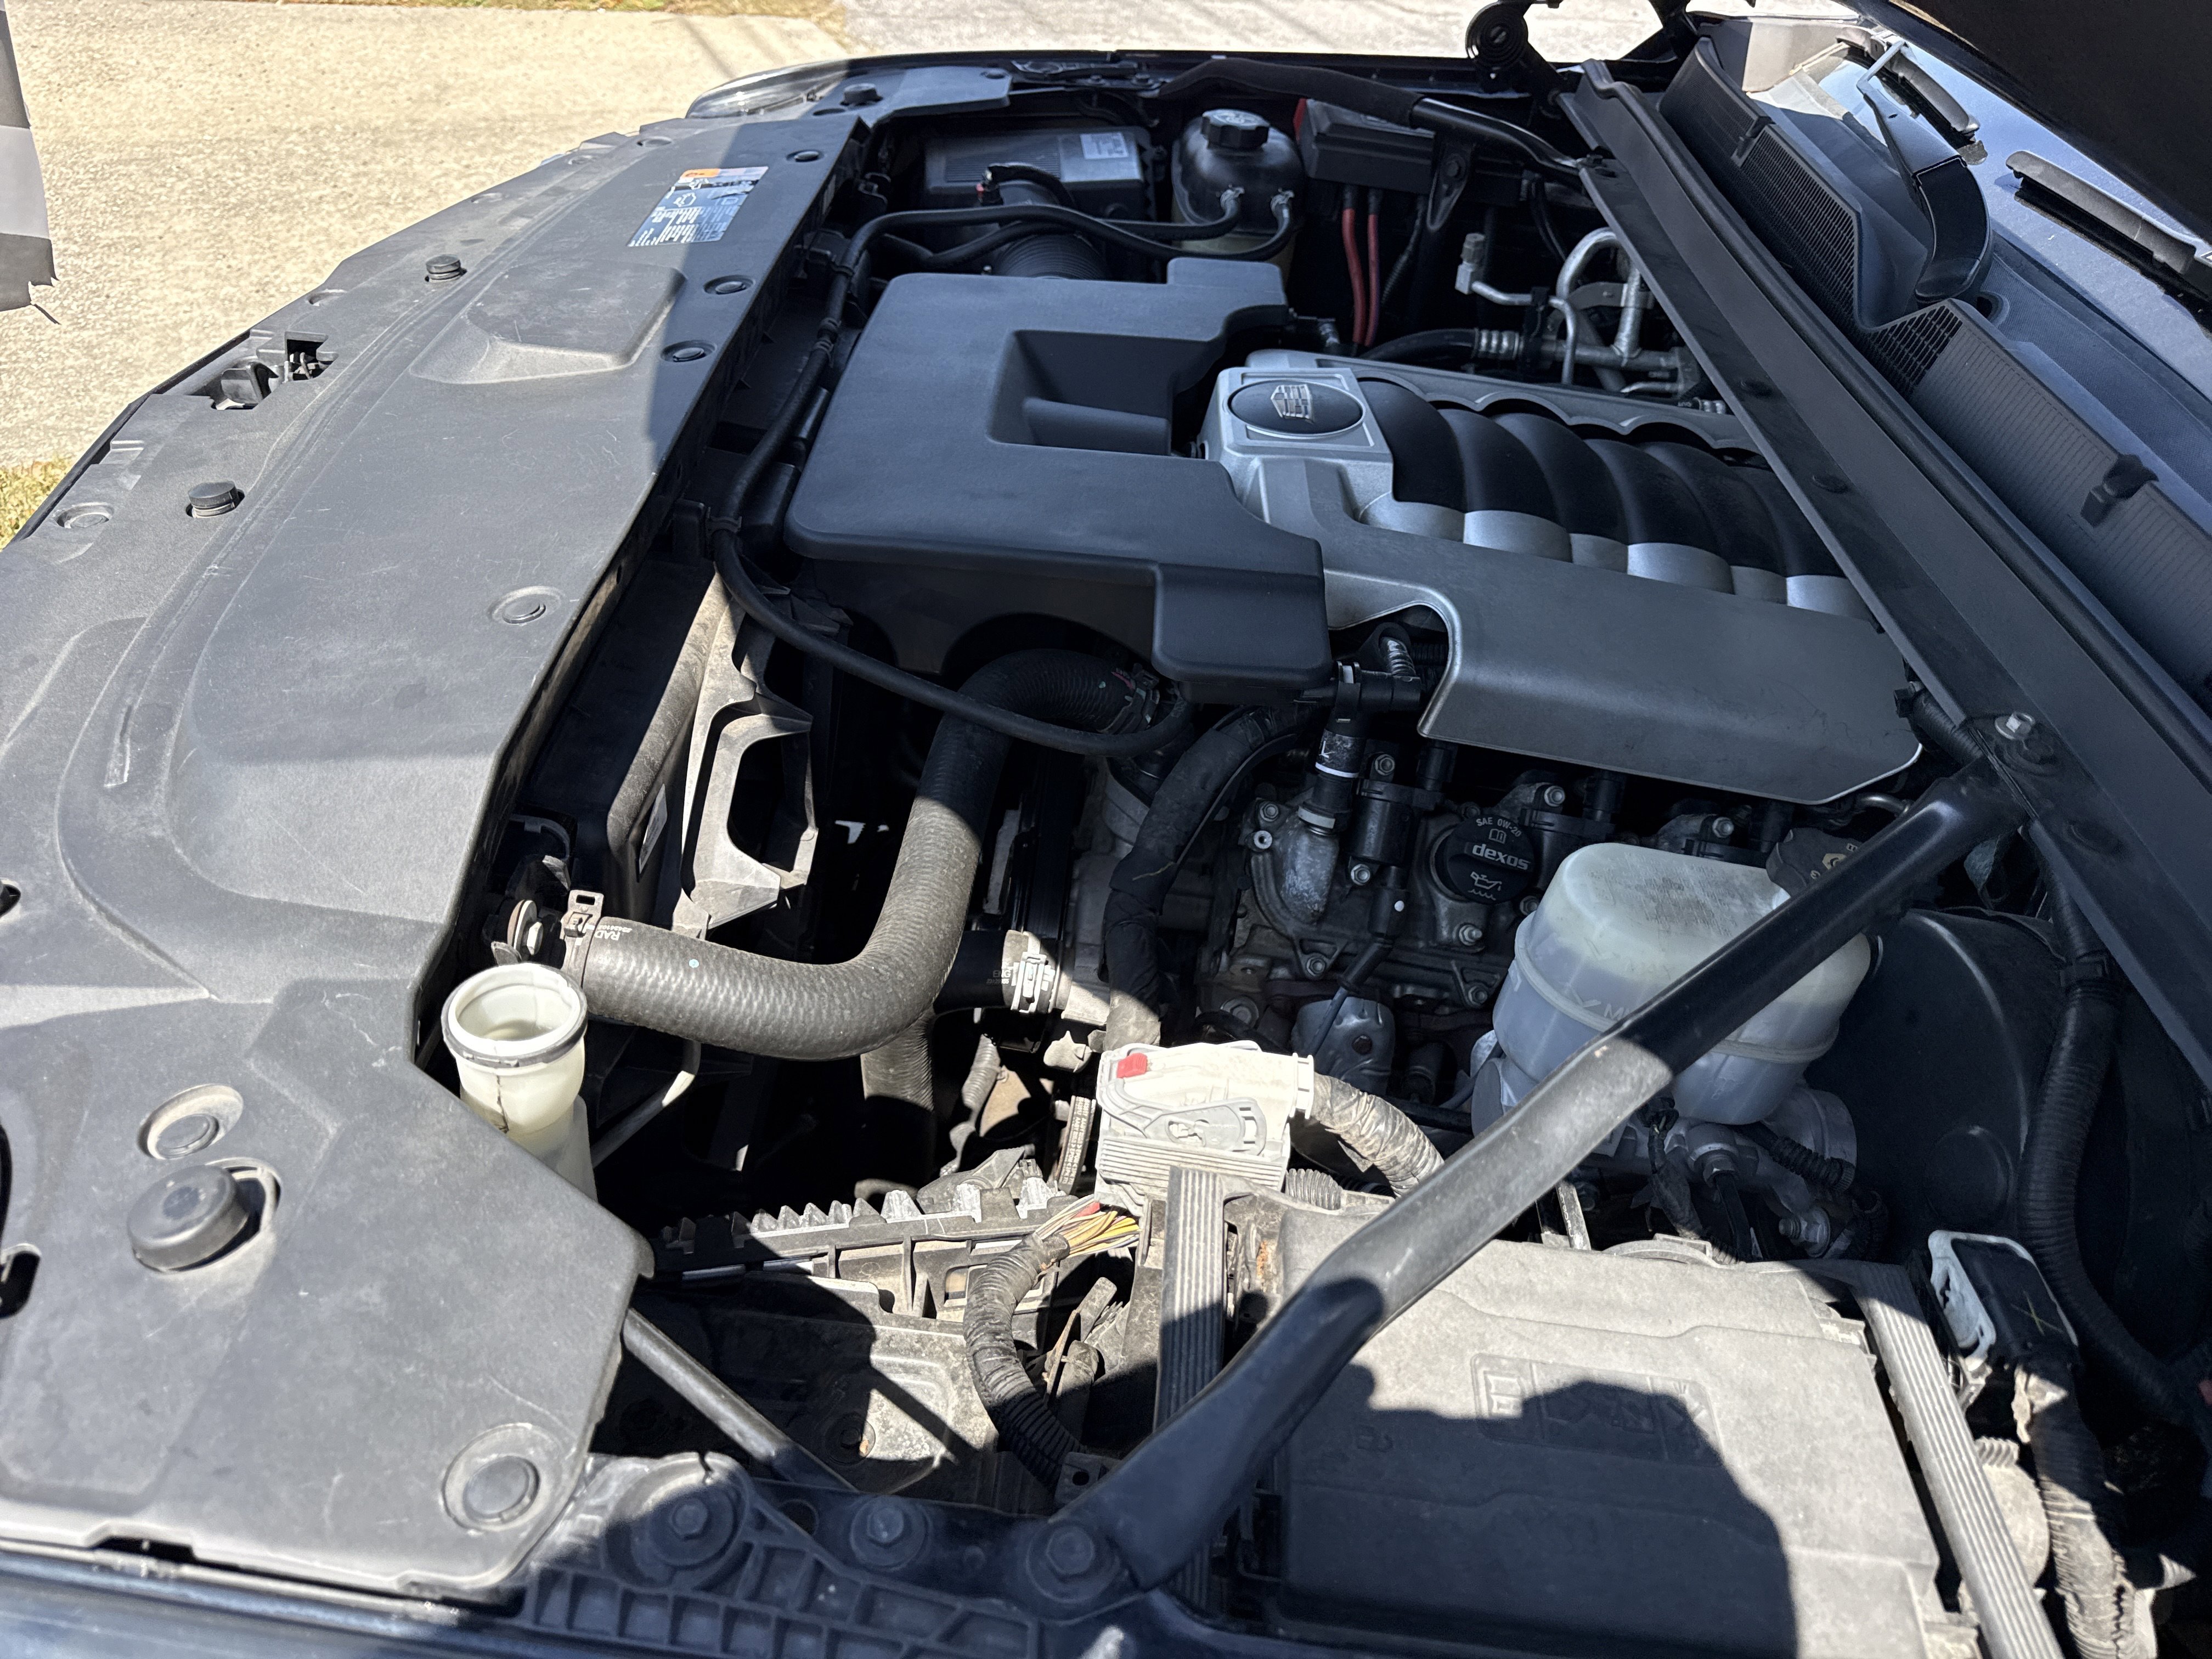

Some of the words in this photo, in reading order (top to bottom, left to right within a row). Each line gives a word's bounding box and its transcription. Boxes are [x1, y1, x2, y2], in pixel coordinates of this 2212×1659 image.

[1476, 817, 1493, 827] SAE
[1497, 819, 1522, 837] 0W-20
[1472, 844, 1532, 871] dexos
[594, 930, 621, 941] RAD
[992, 969, 1012, 978] ENG
